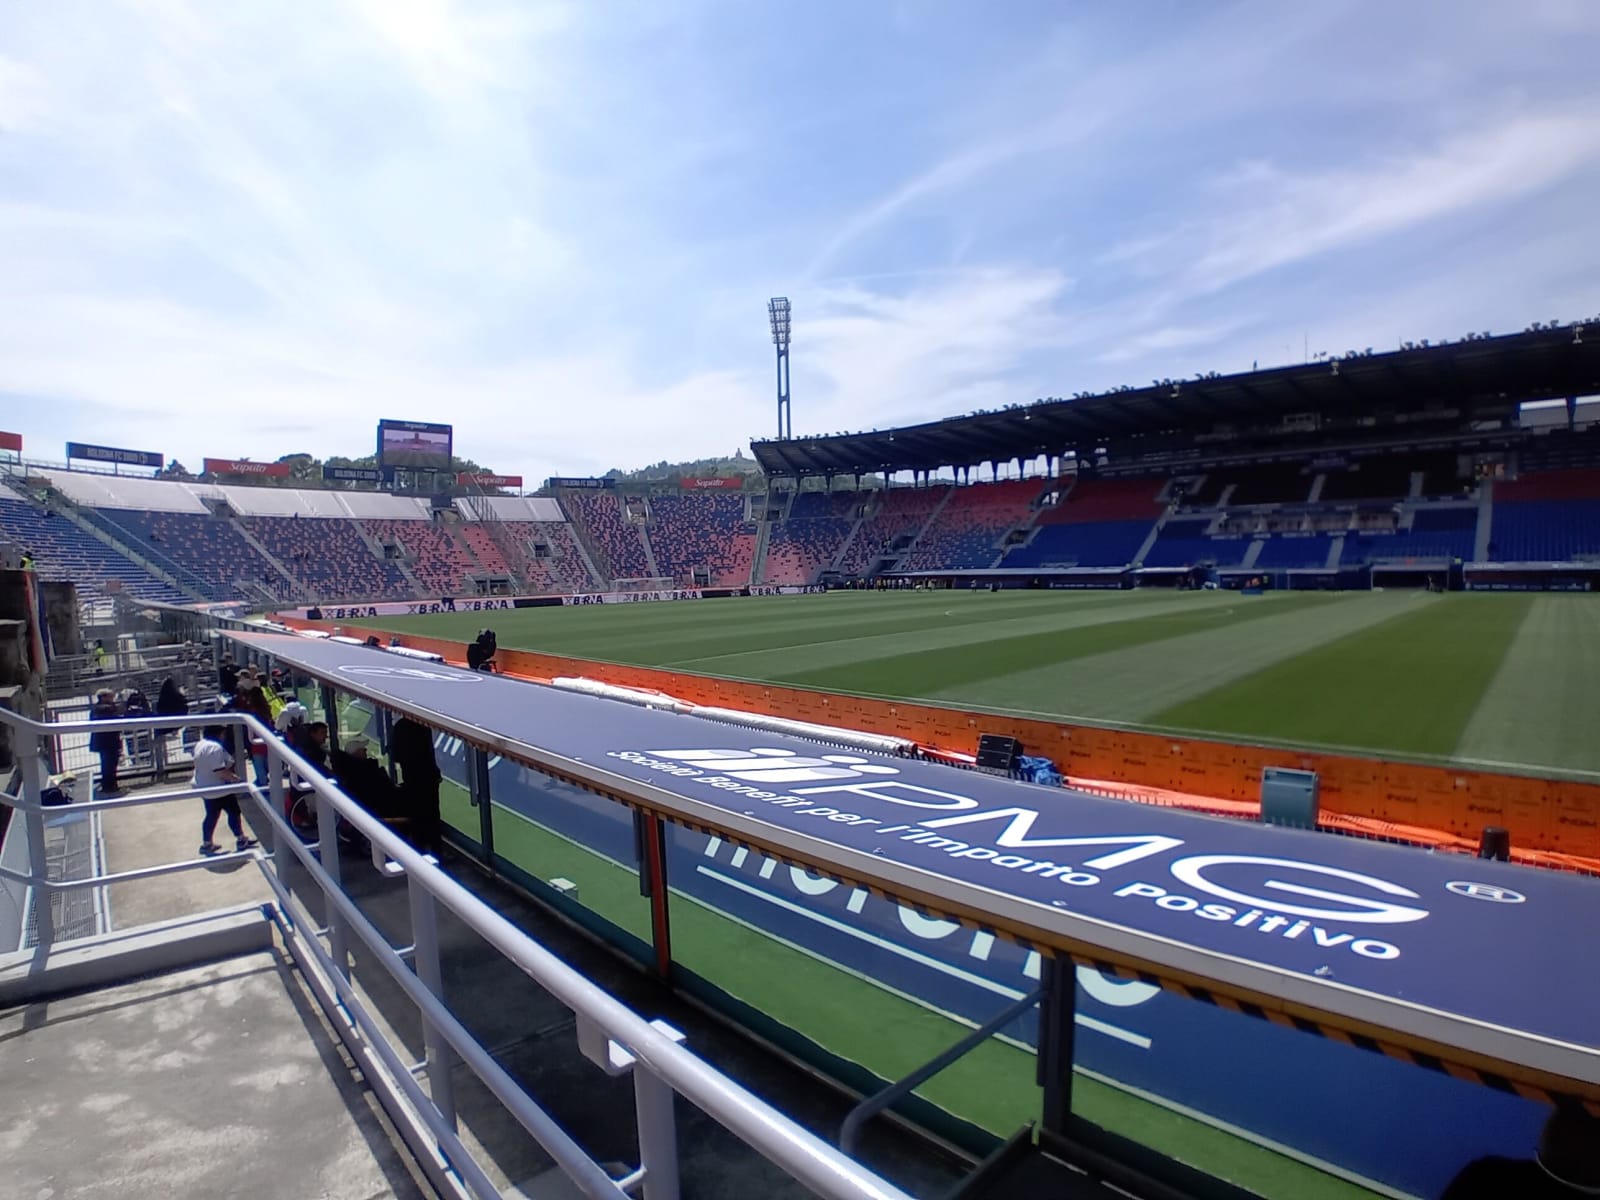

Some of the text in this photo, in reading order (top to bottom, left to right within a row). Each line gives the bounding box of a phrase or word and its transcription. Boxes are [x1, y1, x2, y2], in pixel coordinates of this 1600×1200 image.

[606, 751, 704, 776] Società
[692, 776, 814, 808] Benefit
[794, 806, 882, 826] per
[1113, 882, 1401, 960] Positivo
[789, 780, 1429, 923] PMG
